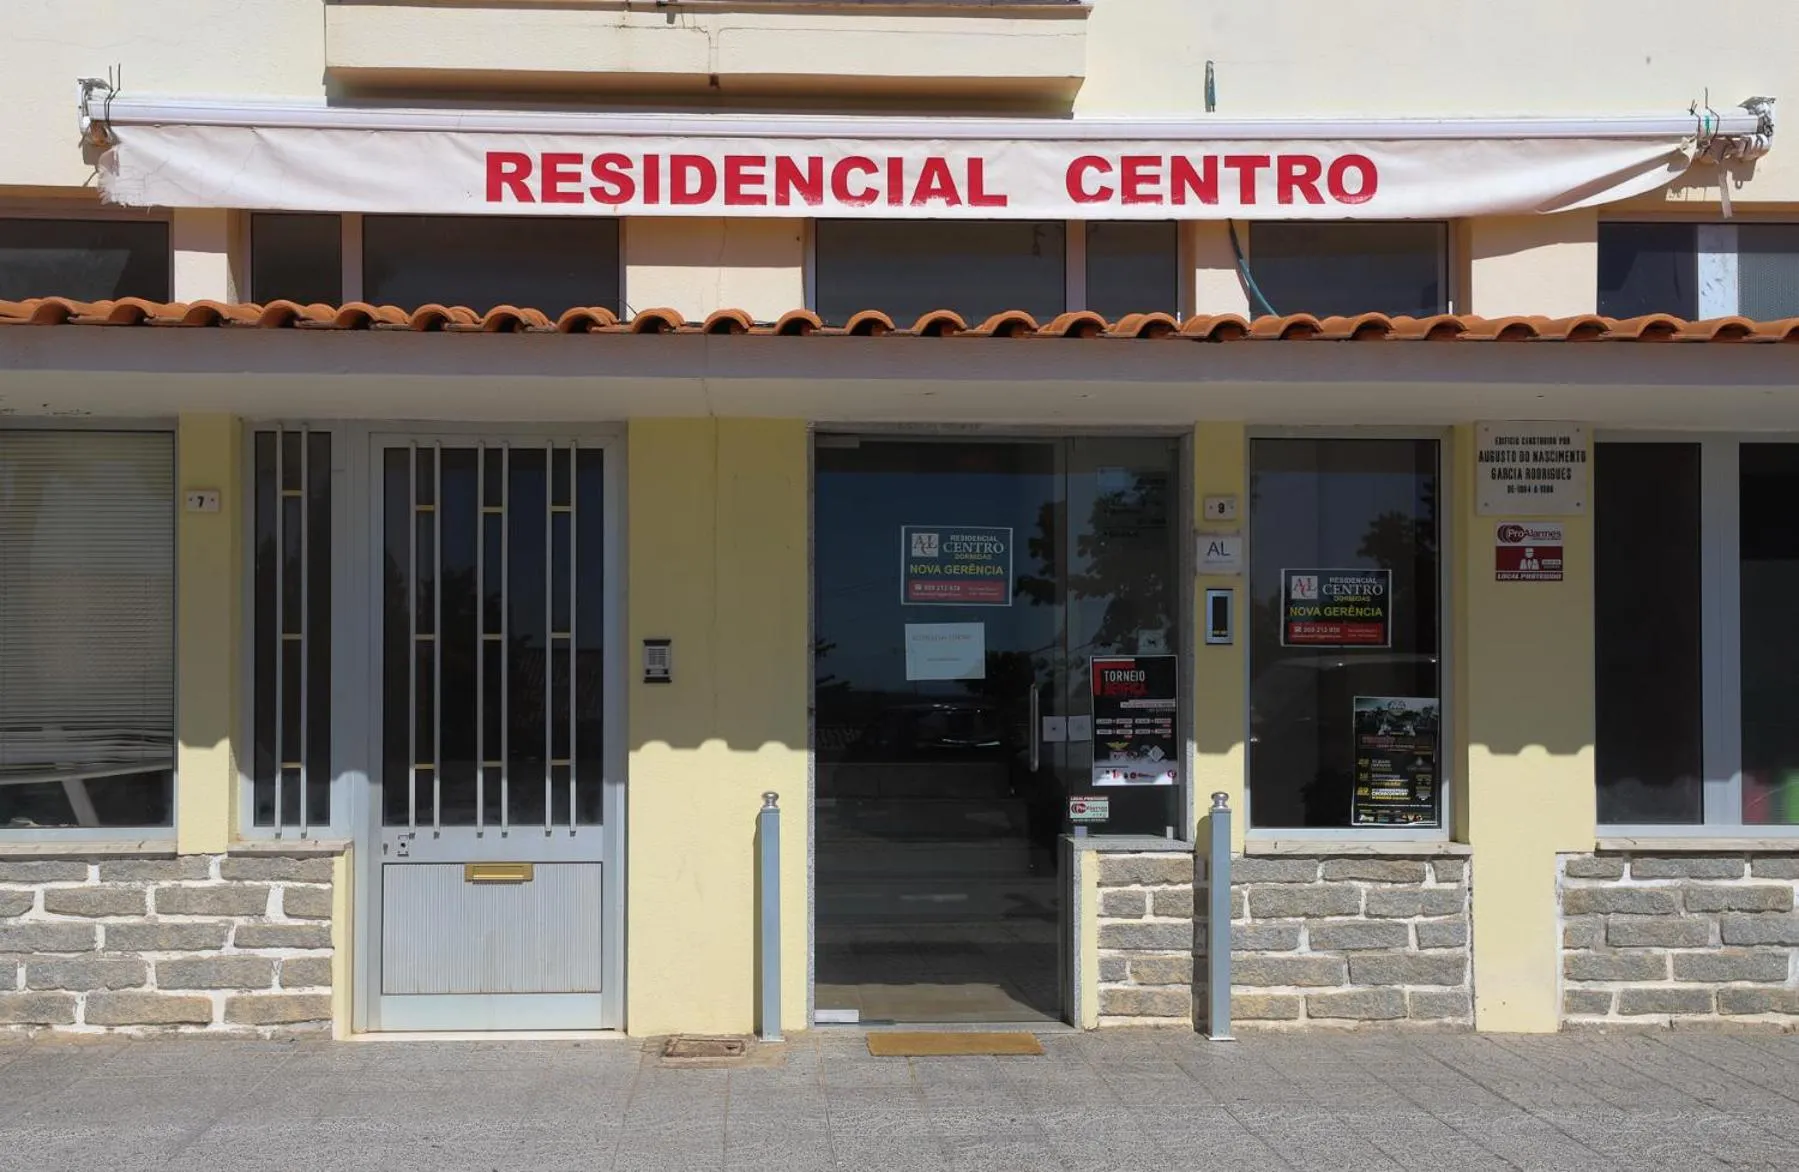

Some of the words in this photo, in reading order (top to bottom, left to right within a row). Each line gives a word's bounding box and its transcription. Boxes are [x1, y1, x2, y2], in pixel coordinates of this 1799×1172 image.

[485, 151, 1008, 208] RESIDENCIAL
[1065, 154, 1379, 205] CENTRO
[1558, 436, 1571, 446] POR
[1478, 450, 1517, 463] AUGUSTO
[1519, 451, 1531, 463] DO
[1532, 451, 1587, 463] NASCIMENTO
[1491, 467, 1523, 481] GARCIA
[1525, 467, 1572, 481] RODRIGUES
[197, 495, 205, 508] 7
[1217, 502, 1226, 514] 9
[943, 541, 1004, 554] CENTRO
[1207, 541, 1231, 557] AL
[910, 563, 942, 575] NOVA
[945, 561, 1005, 576] GERÊNCIA
[1329, 576, 1378, 584] RESIDENCIAL
[1322, 583, 1384, 596] CENTRO
[1289, 606, 1321, 617] NOVA
[1323, 604, 1383, 617] GERÊNCIA
[1104, 670, 1146, 683] TORNEIO
